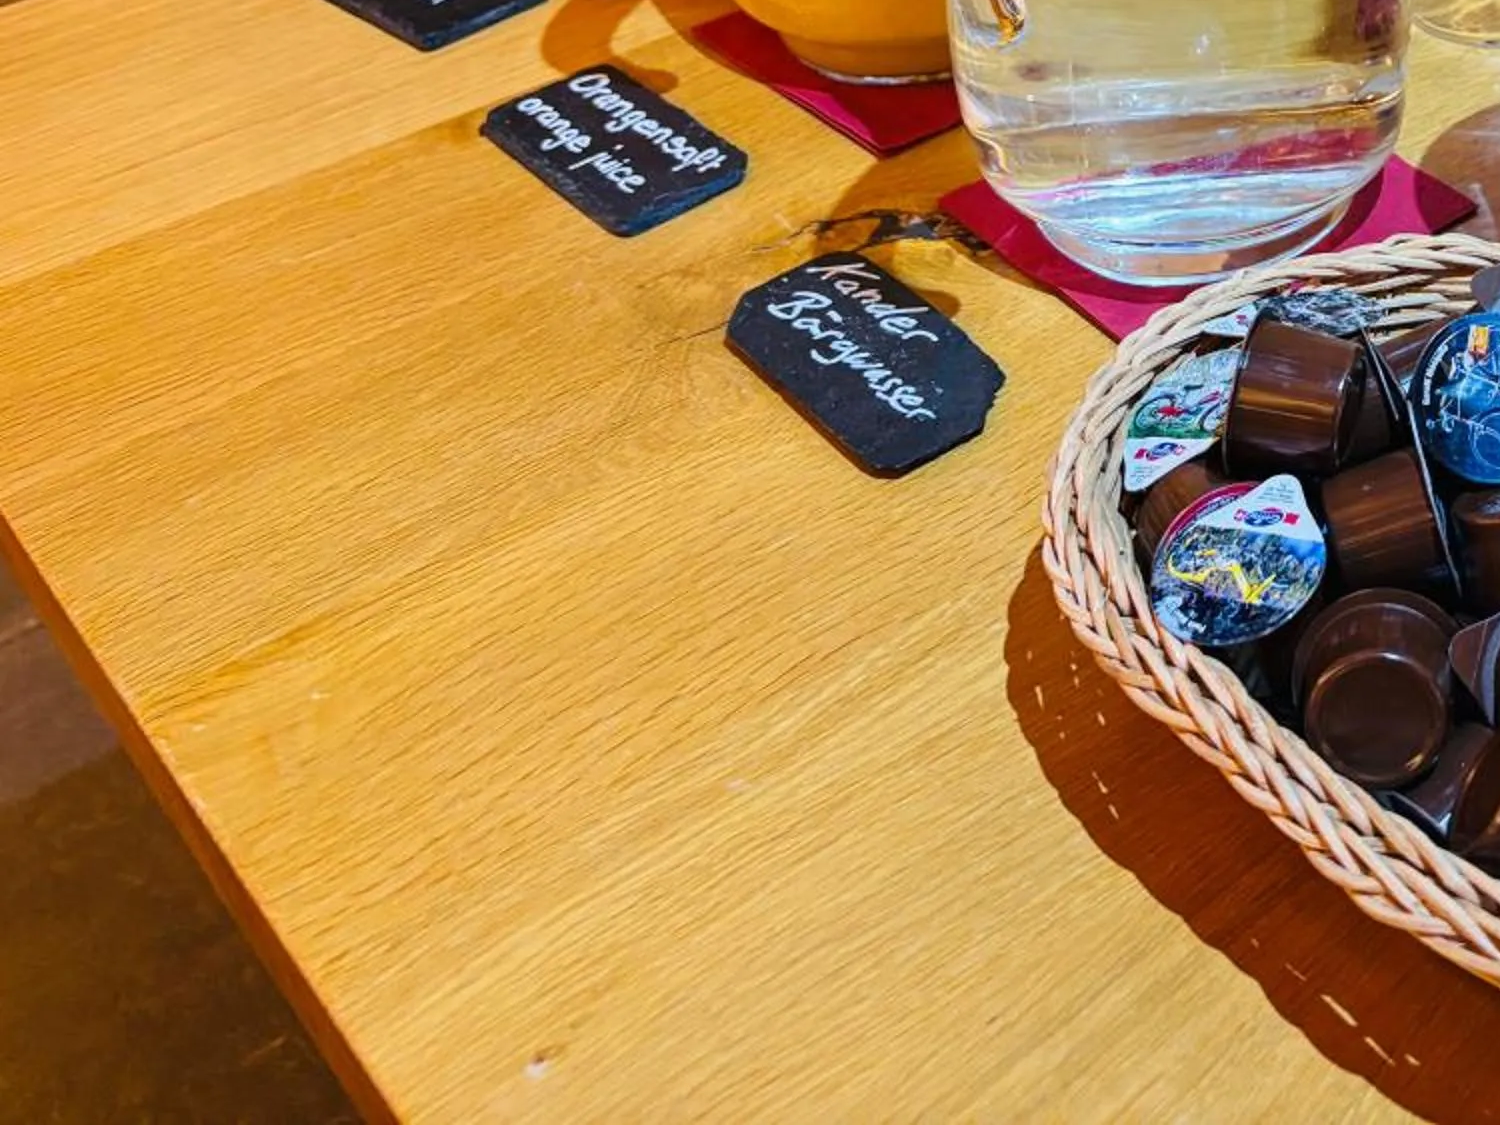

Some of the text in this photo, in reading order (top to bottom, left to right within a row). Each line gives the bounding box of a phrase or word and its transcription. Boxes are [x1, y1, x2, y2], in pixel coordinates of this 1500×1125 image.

[515, 97, 647, 195] orange juice
[567, 72, 728, 174] Orangensaft
[805, 262, 940, 343] Kander
